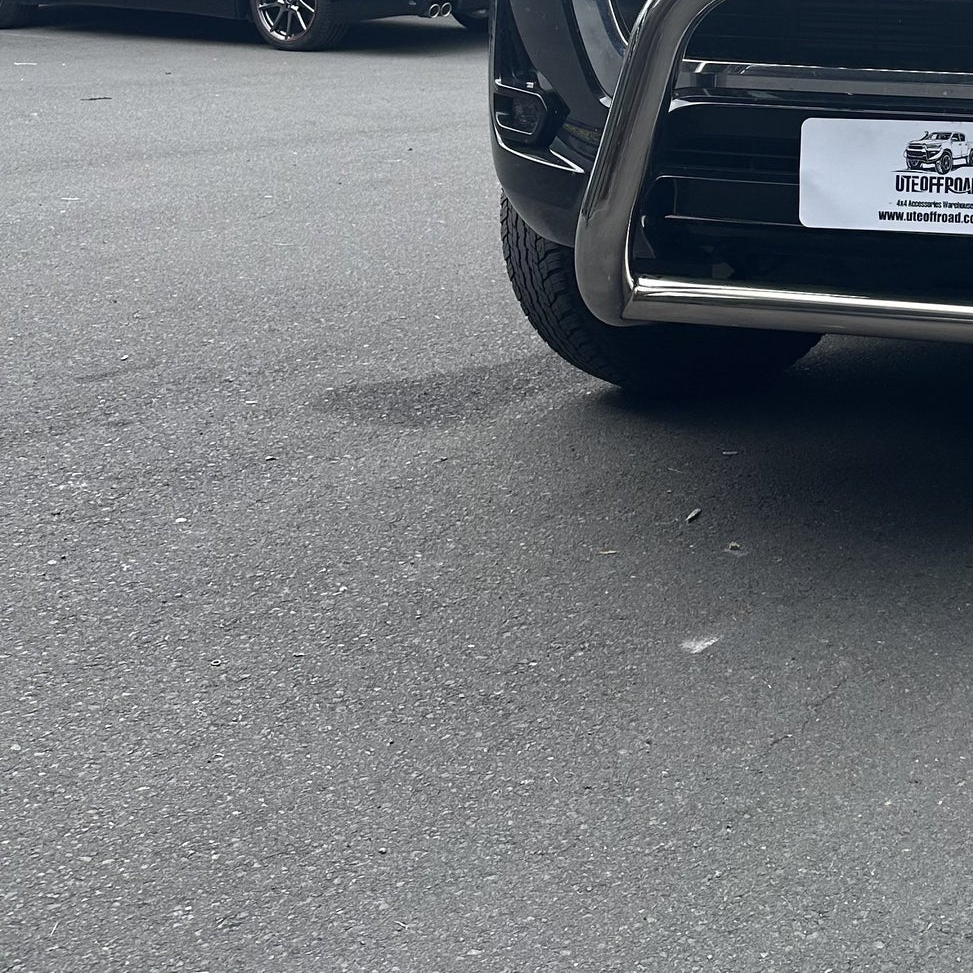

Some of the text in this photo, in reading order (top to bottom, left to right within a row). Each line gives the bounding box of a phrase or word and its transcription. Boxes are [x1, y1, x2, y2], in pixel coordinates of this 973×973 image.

[896, 199, 973, 209] 4x4 Accessories Warehouse
